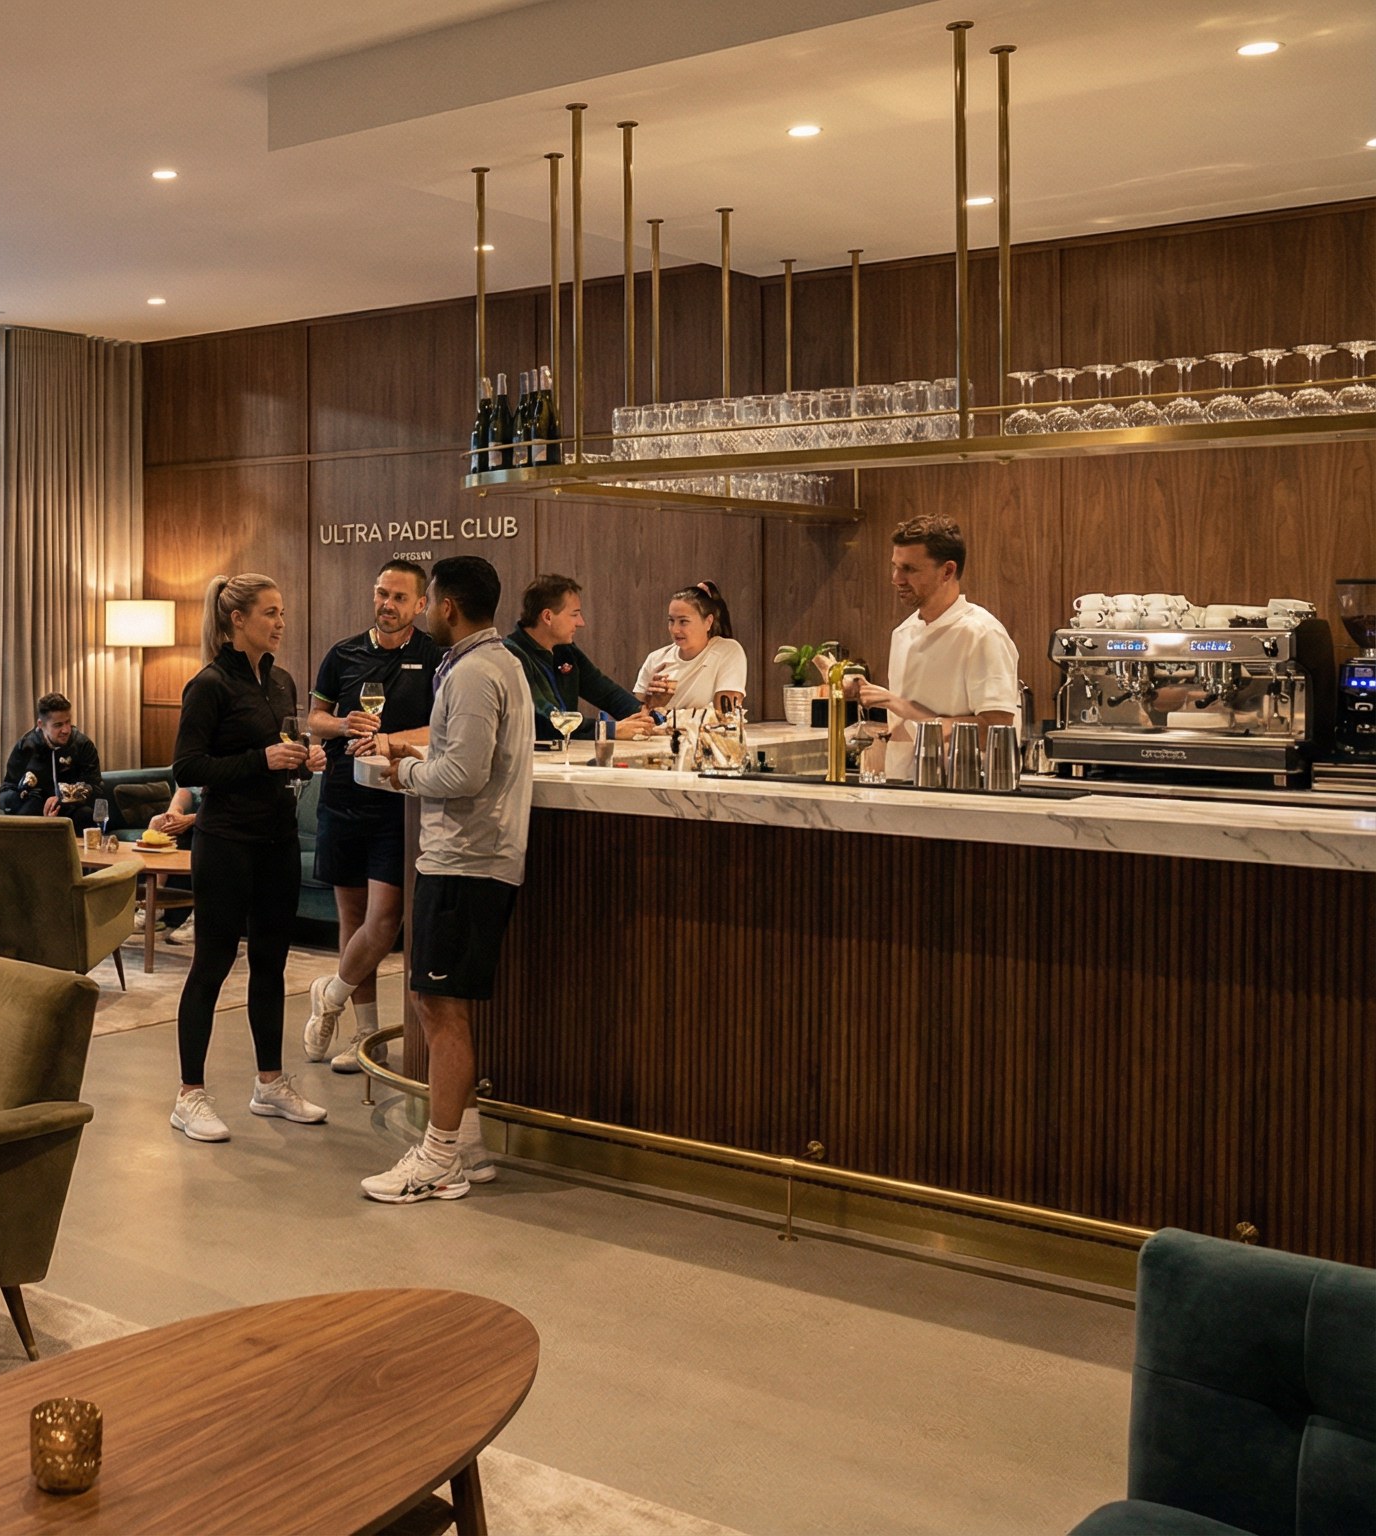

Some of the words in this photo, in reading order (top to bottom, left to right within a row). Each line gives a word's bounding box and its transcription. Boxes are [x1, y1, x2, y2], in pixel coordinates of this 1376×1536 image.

[320, 523, 382, 544] ULTRA
[389, 520, 454, 542] PADEL
[460, 516, 519, 539] CLUB
